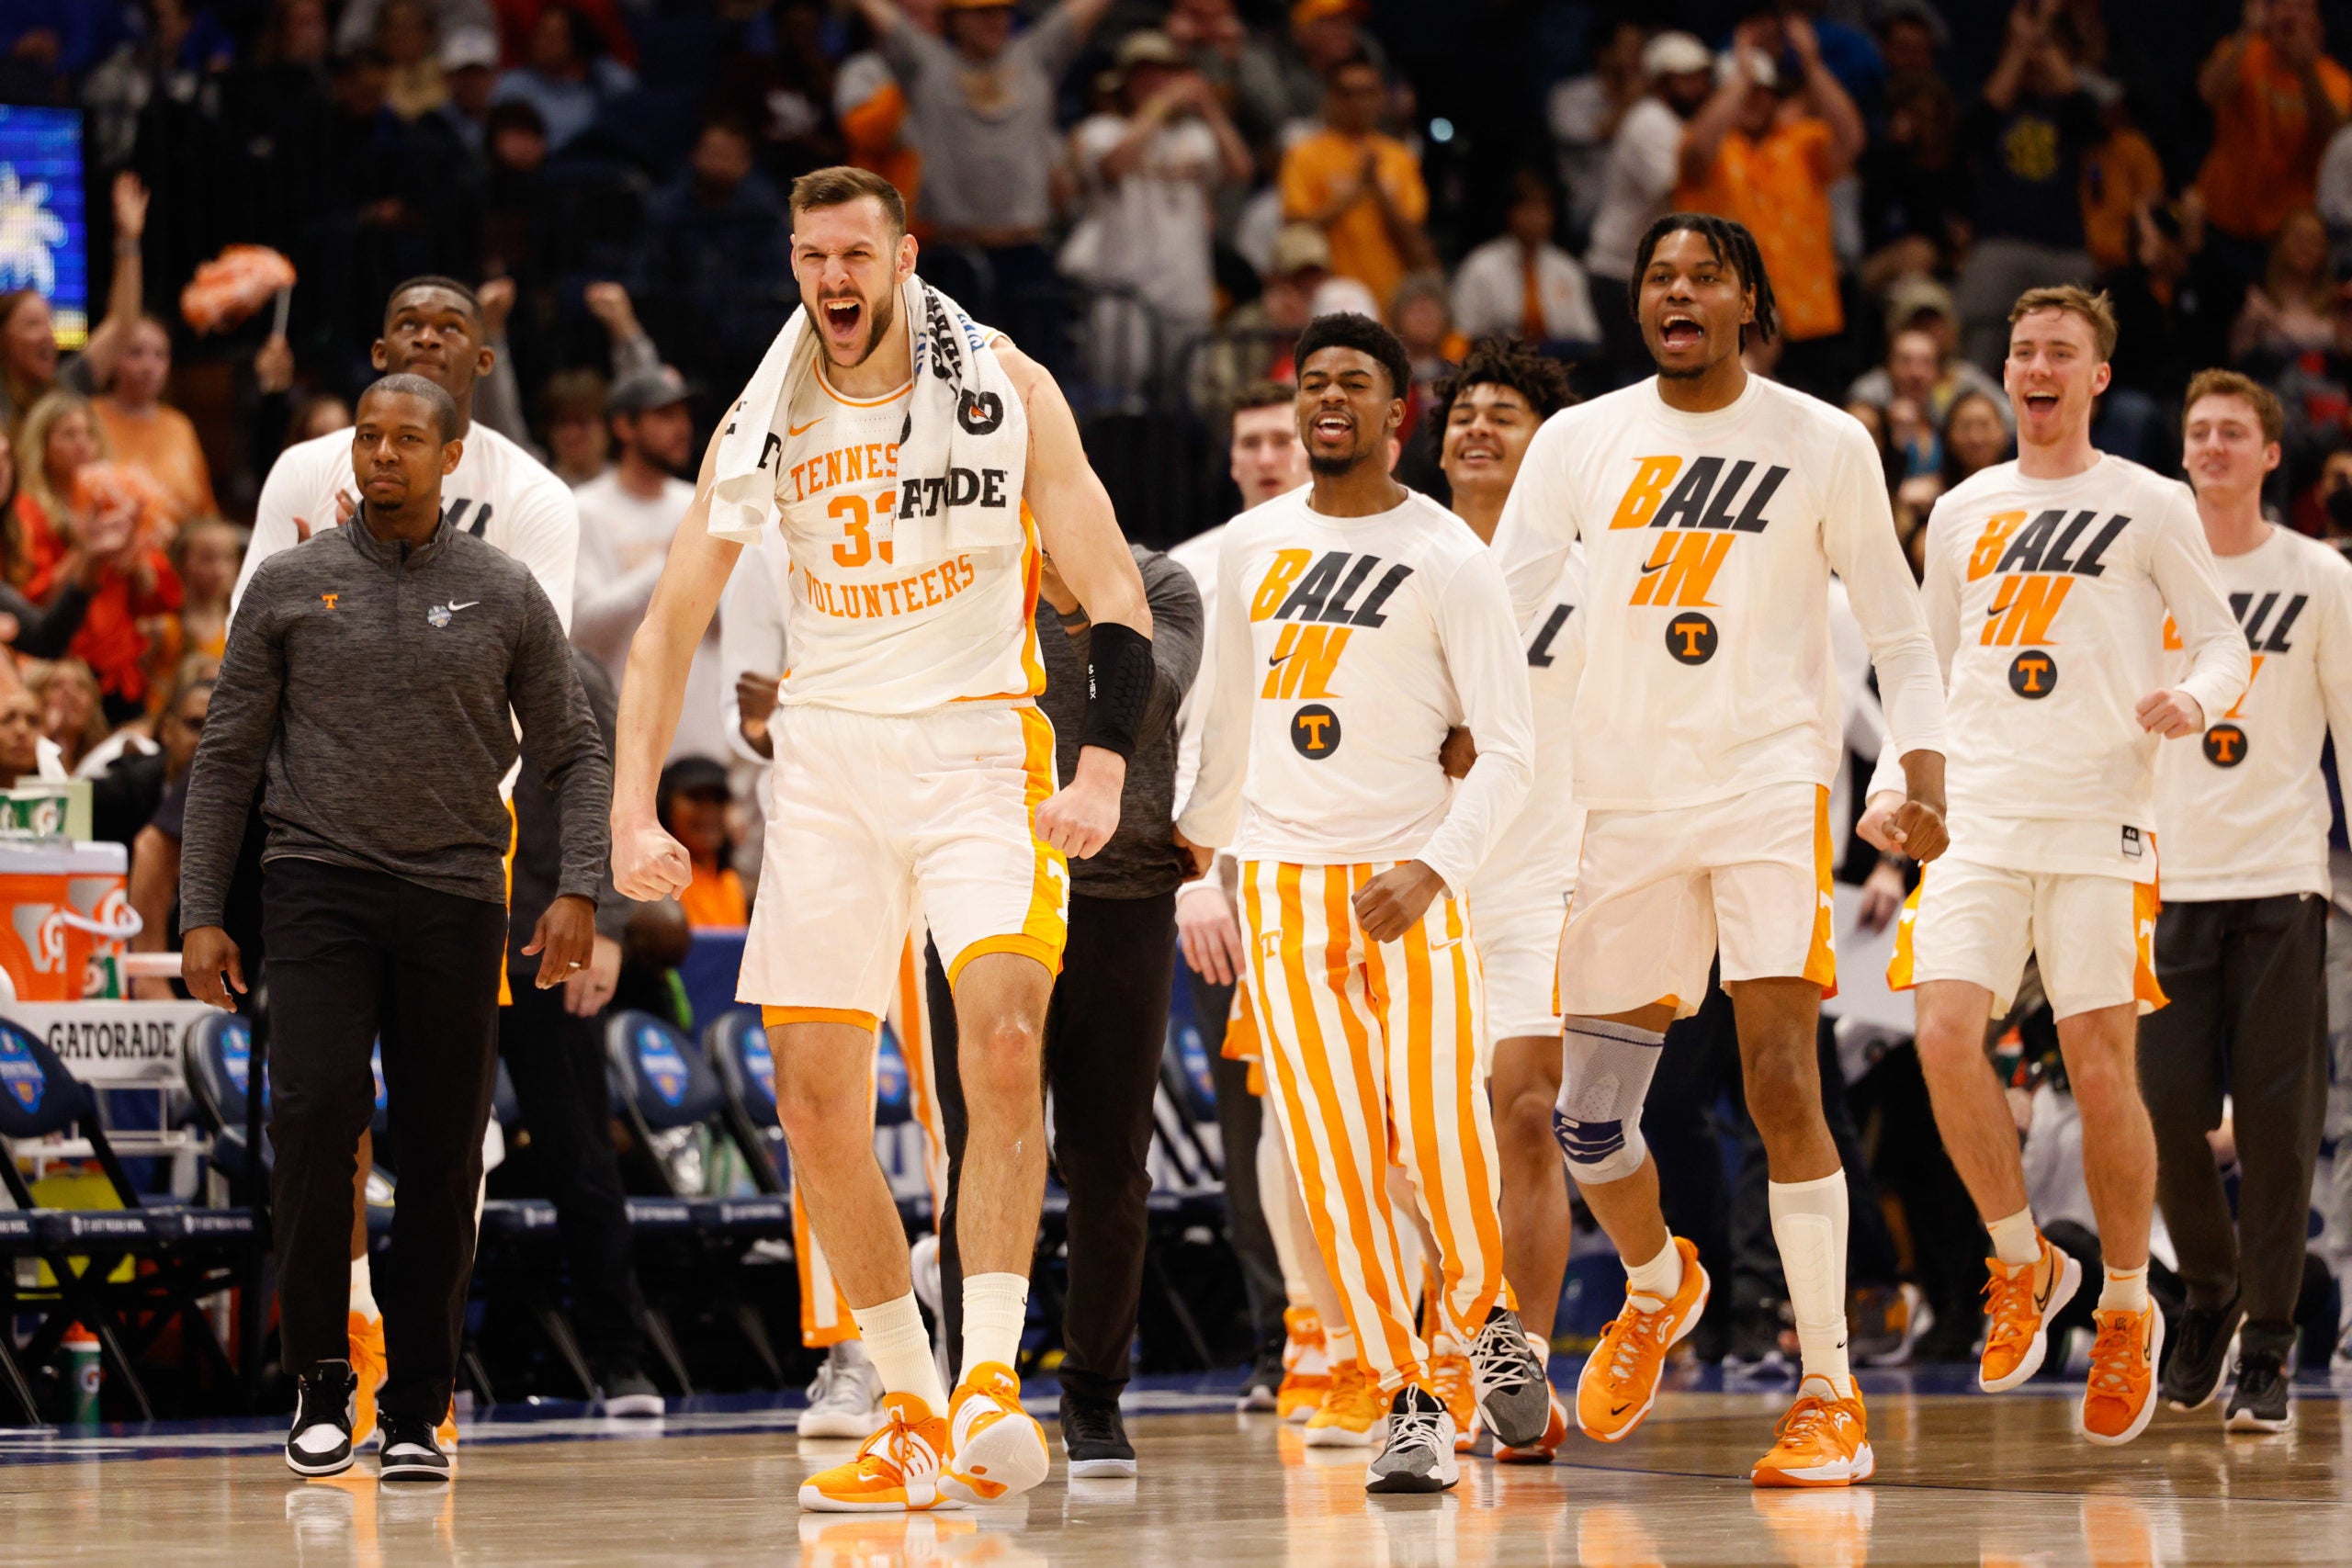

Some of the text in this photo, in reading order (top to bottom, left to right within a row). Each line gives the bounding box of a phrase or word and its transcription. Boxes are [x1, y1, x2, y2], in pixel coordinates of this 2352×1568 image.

[791, 443, 900, 502] TENNES
[1609, 456, 1791, 534] BALL
[1629, 531, 1736, 607] IN
[1967, 510, 2132, 582] BALL
[322, 594, 338, 609] T
[804, 554, 975, 619] VOLUNTEERS
[1250, 548, 1415, 629] BALL
[1979, 575, 2075, 647] IN
[1261, 623, 1354, 700] IN
[1675, 623, 1708, 656] T
[2018, 659, 2048, 692] T
[1299, 715, 1330, 750] T
[2210, 730, 2239, 761] T
[1259, 928, 1283, 959] T
[49, 1022, 175, 1058] GATORADE
